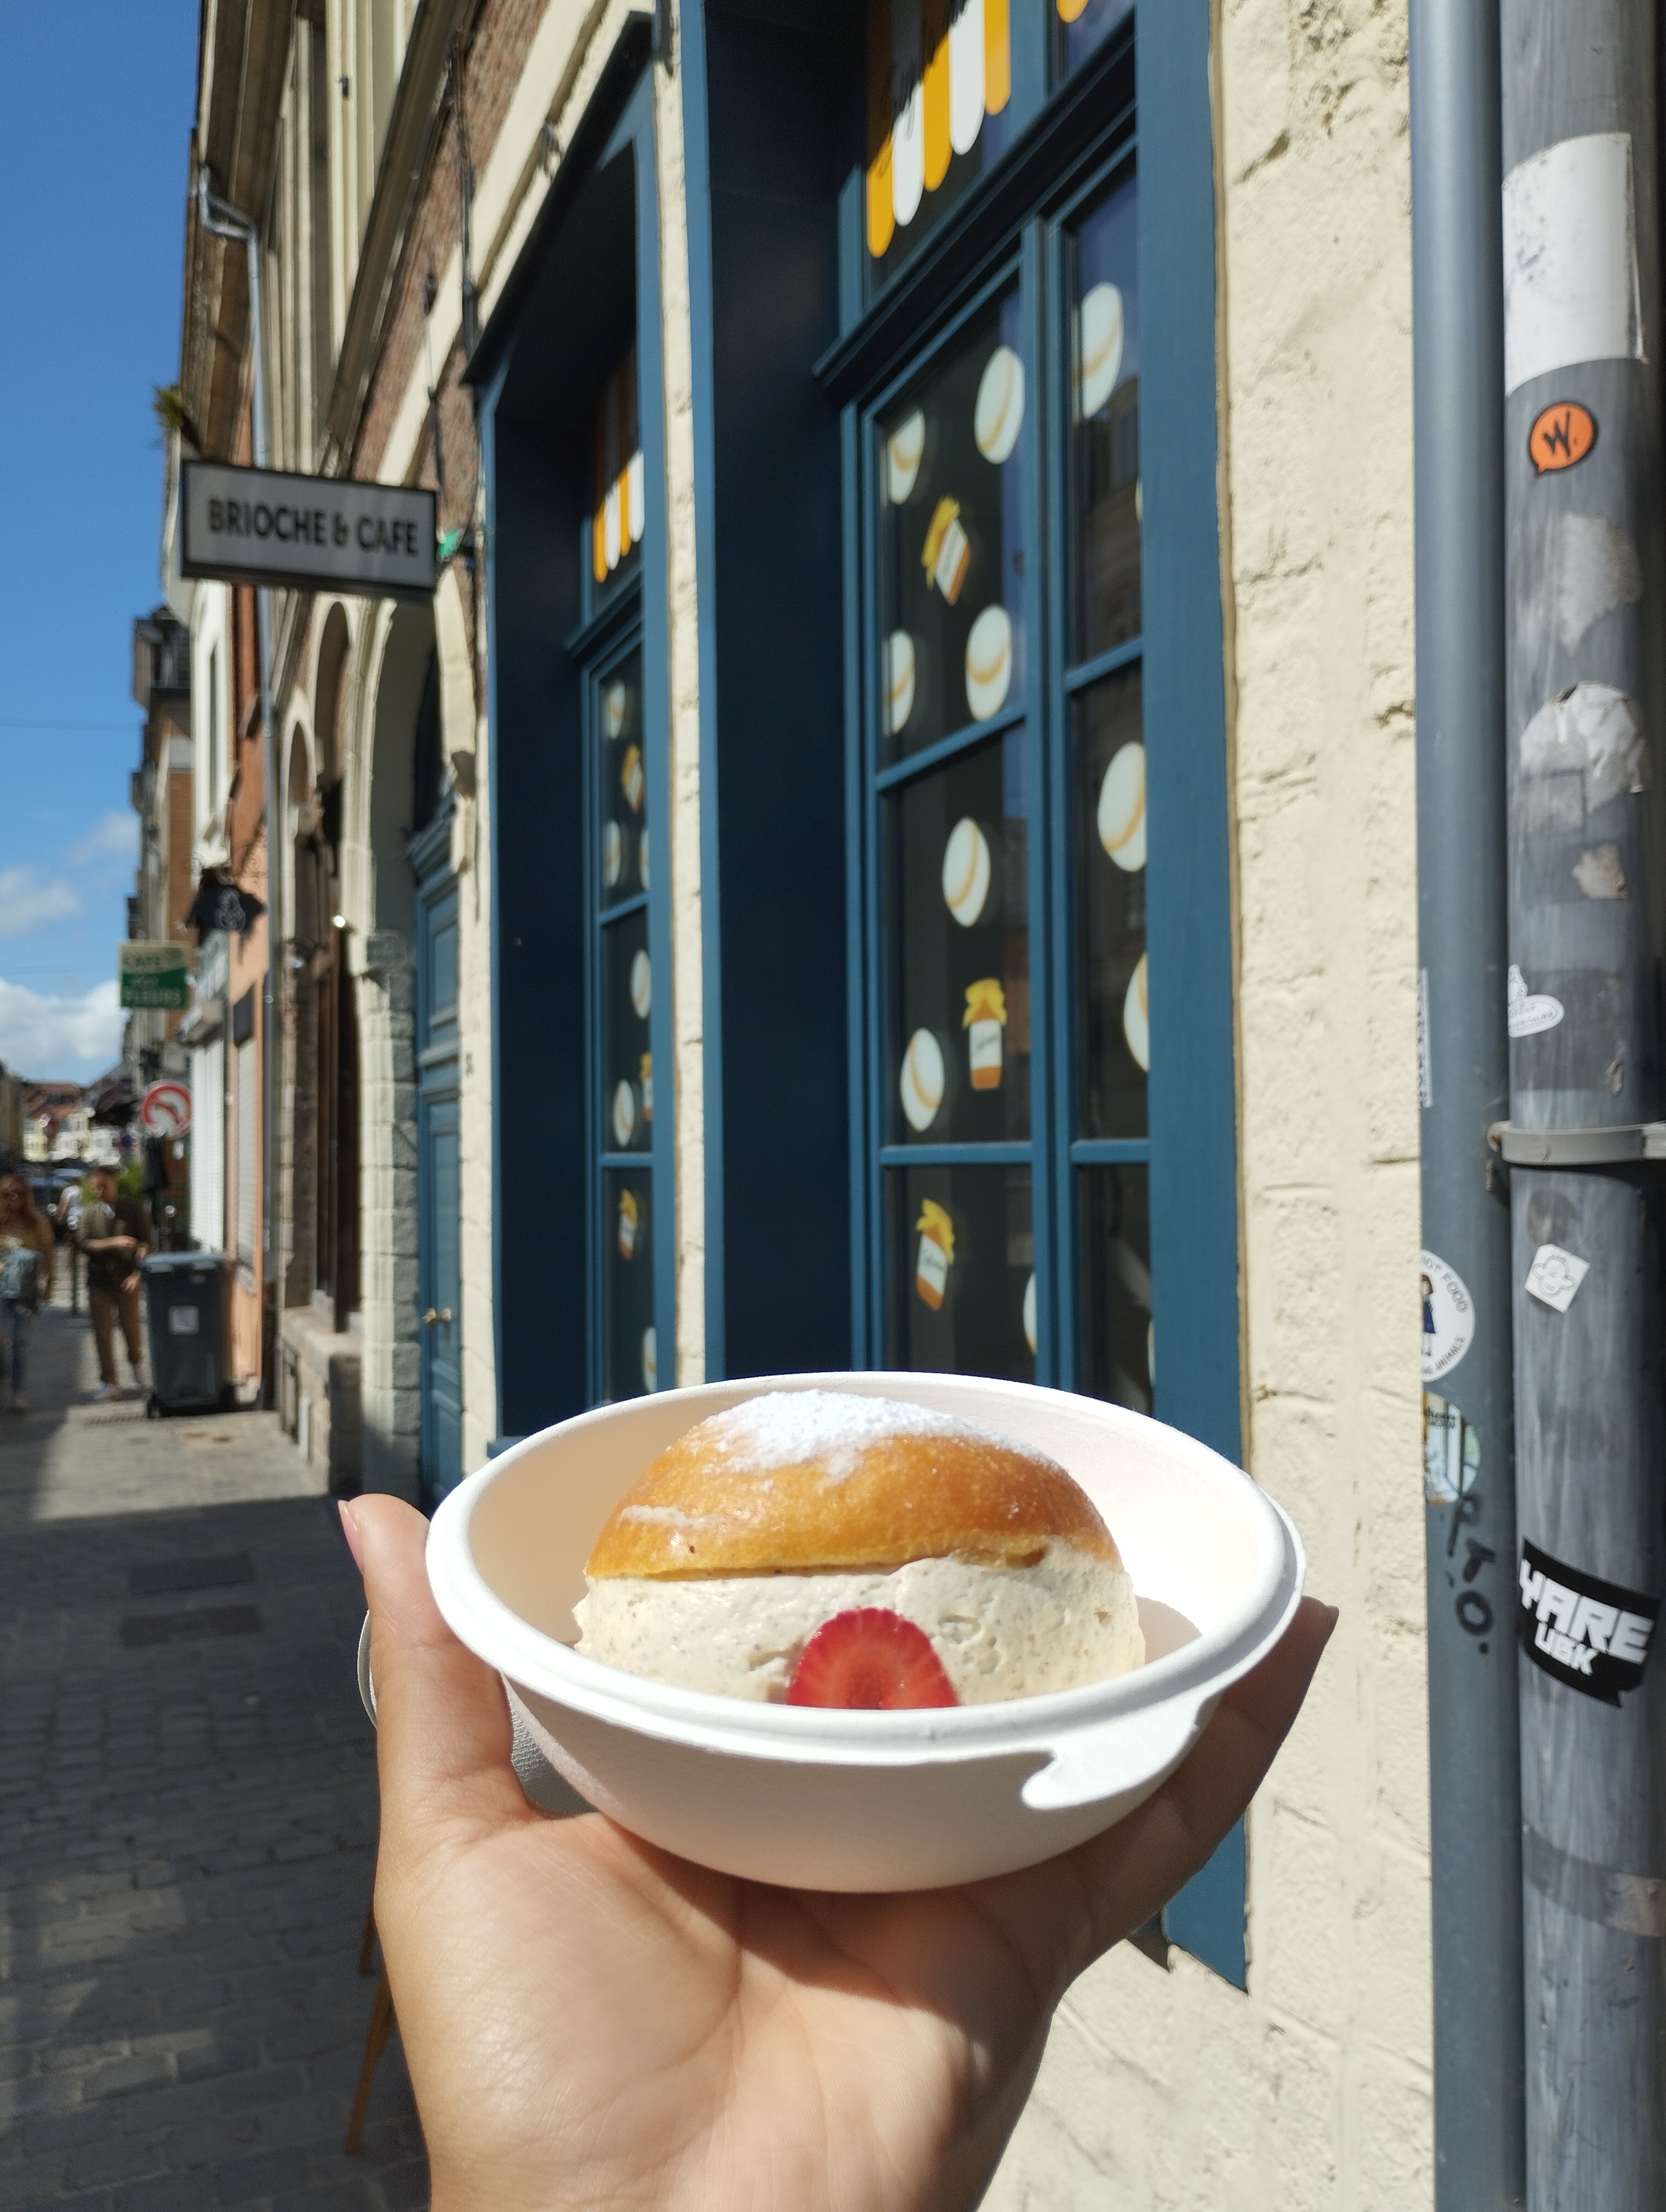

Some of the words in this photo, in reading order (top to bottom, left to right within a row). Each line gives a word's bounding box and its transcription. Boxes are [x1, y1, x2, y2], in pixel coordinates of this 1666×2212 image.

[208, 497, 326, 545] BRIOCHE
[332, 511, 348, 549] &
[356, 515, 418, 557] CAFE
[1440, 1271, 1468, 1314] FOOD
